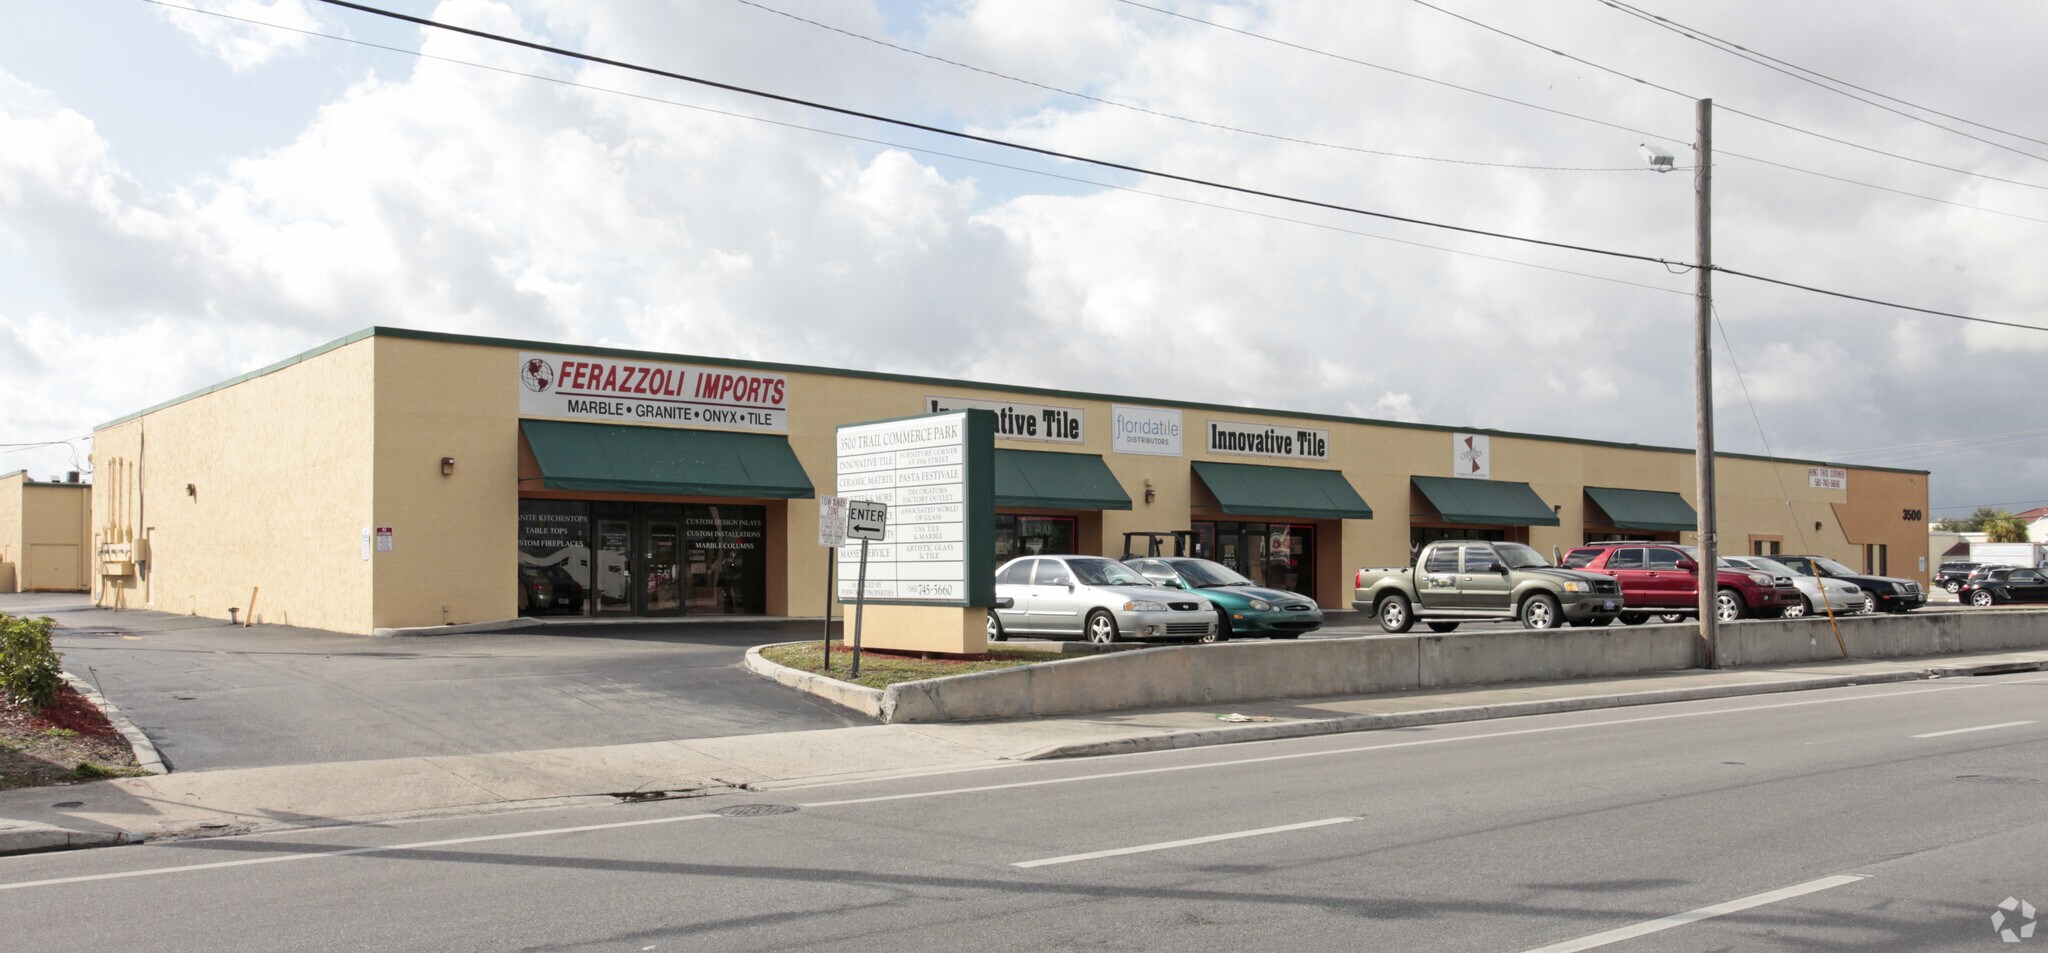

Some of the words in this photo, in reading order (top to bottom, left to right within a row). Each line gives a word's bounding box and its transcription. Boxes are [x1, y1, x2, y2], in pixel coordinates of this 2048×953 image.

[557, 360, 685, 397] FERAZZOLI
[695, 372, 785, 405] IMPORTS
[568, 399, 624, 416] MARBLE
[635, 404, 692, 420] GRANITE
[703, 409, 737, 424] ONYX
[747, 412, 772, 426] TILE
[1042, 409, 1079, 440] Tile
[1116, 414, 1179, 440] floridatile
[840, 437, 857, 451] 3500
[858, 434, 882, 449] TRAIL
[883, 427, 932, 446] COMMERCE
[934, 424, 959, 440] PARK
[1126, 436, 1170, 446] DISTRIBUTORS
[1211, 423, 1293, 455] Innovative
[1297, 430, 1326, 457] Tile
[899, 449, 933, 459] FURNITURE
[933, 447, 958, 456] CORNER
[839, 457, 879, 470] INNOVATIVE
[879, 455, 893, 466] TILE
[927, 456, 949, 464] STREET
[839, 477, 867, 488] CERAMIC
[867, 474, 894, 485] MATRIX
[899, 472, 920, 483] PASTA
[921, 469, 959, 481] FESTIVALE
[908, 487, 947, 497] DECORATORS
[902, 495, 928, 504] FACTORY
[929, 494, 953, 502] OUTLET
[850, 507, 884, 522] ENTER
[900, 506, 939, 515] ASSOCIATED
[939, 505, 958, 513] WORLD
[1902, 508, 1922, 522] 3500
[538, 514, 588, 523] KITCHENTOPS
[714, 518, 738, 526] DESIGN
[926, 513, 943, 521] GLASS
[714, 530, 761, 538] INSTALLATIONS
[914, 525, 926, 533] USA
[918, 532, 943, 540] MARBLE
[840, 548, 862, 559] MASSE
[867, 547, 891, 558] ERVICE
[905, 544, 933, 552] ARTISTIC
[934, 543, 954, 551] GLASS
[925, 552, 940, 560] TILE
[918, 584, 953, 596] 745-5660
